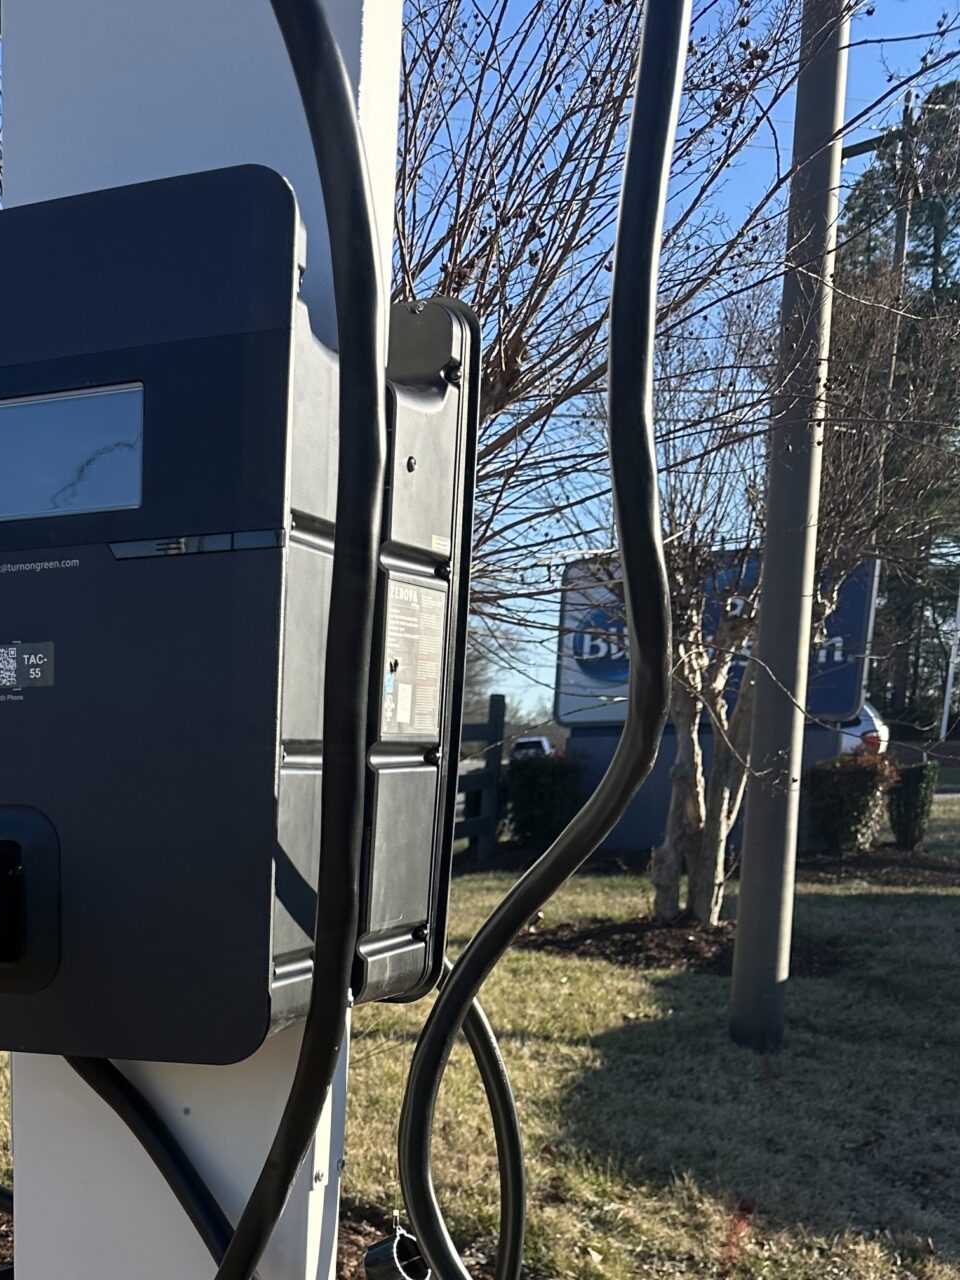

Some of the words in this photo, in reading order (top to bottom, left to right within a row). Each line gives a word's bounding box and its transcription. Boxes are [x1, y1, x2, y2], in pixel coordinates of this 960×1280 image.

[22, 653, 48, 665] TAC-
[29, 668, 41, 678] 55
[6, 693, 24, 701] Phone
